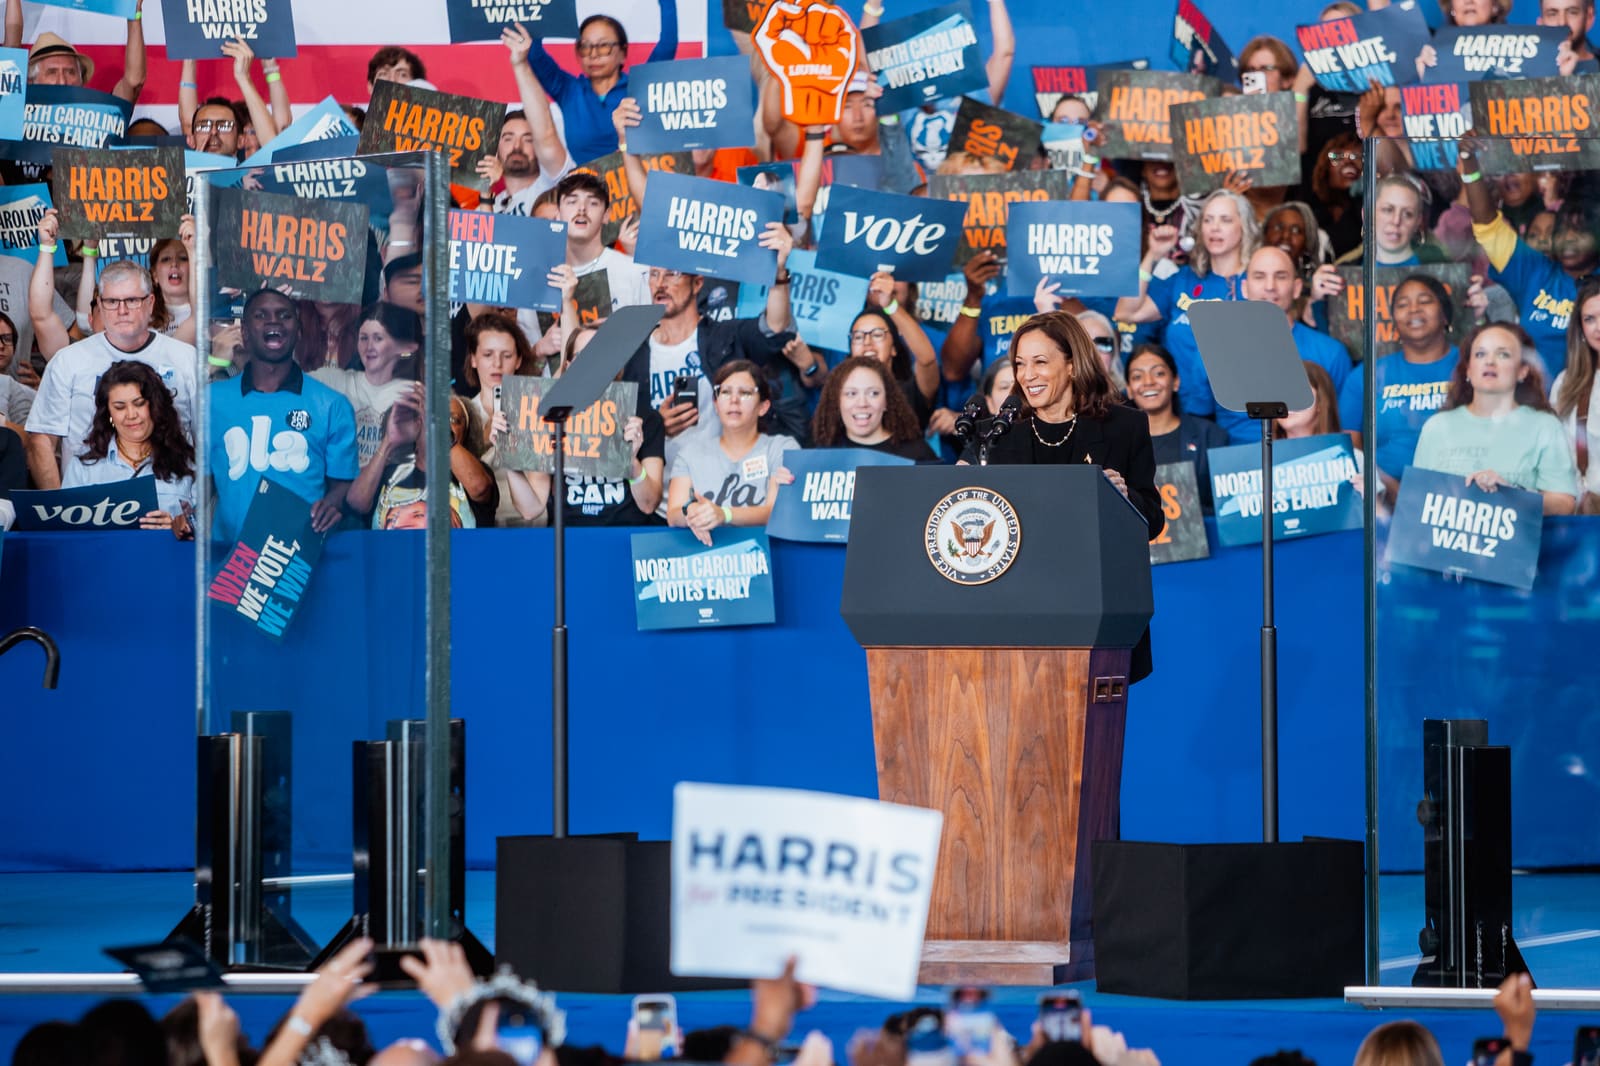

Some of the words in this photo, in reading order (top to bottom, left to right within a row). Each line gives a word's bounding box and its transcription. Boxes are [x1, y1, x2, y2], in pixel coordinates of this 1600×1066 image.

[188, 0, 267, 23] HARRIS
[485, 4, 542, 23] WALZ
[202, 23, 258, 39] WALZ
[1296, 18, 1359, 51] WHEN
[1453, 34, 1541, 58] HARRIS
[867, 41, 910, 72] NORTH
[912, 23, 977, 60] CAROLINA
[1304, 48, 1338, 74] WE
[883, 61, 925, 89] VOTES
[928, 49, 965, 79] EARLY
[1032, 67, 1088, 92] WHEN
[1314, 69, 1346, 91] WE
[648, 78, 727, 113] HARRIS
[1402, 83, 1460, 115] WHEN
[59, 105, 125, 139] CAROLINA
[384, 99, 485, 151] HARRIS
[660, 110, 716, 131] WALZ
[1487, 93, 1590, 136] HARRIS
[64, 126, 109, 149] EARLY
[1185, 111, 1279, 155] HARRIS
[1510, 133, 1580, 155] WALZ
[1199, 147, 1266, 175] WALZ
[70, 166, 168, 200] HARRIS
[294, 180, 357, 199] WALZ
[84, 203, 154, 221] WALZ
[667, 196, 757, 241] HARRIS
[241, 209, 347, 261] HARRIS
[678, 230, 740, 258] WALZ
[843, 212, 946, 255] vote
[1028, 224, 1113, 256] HARRIS
[253, 254, 328, 283] WALZ
[466, 243, 525, 280] VOTE,
[1038, 256, 1100, 275] WALZ
[465, 272, 511, 303] WIN
[1381, 398, 1407, 414] for
[1273, 459, 1357, 489] CAROLINA
[567, 482, 625, 505] CAN
[957, 491, 969, 501] OF
[971, 490, 989, 500] THE
[1291, 484, 1339, 512] EARLY
[32, 497, 140, 526] vote
[928, 497, 954, 555] PRESIDENT
[992, 495, 1018, 535] UNITED
[1421, 493, 1517, 541] HARRIS
[1432, 527, 1499, 558] WALZ
[207, 541, 259, 605] WHEN
[250, 534, 301, 588] VOTE,
[635, 557, 689, 582] NORTH
[692, 551, 768, 577] CAROLINA
[936, 556, 957, 579] VICE
[988, 541, 1018, 577] STATES
[273, 554, 312, 602] WIN
[656, 579, 704, 603] VOTES
[707, 576, 752, 600] EARLY
[237, 581, 269, 622] WE
[257, 596, 294, 637] WE
[687, 830, 921, 894] HARRIS
[728, 883, 912, 923] PRESIDENT
